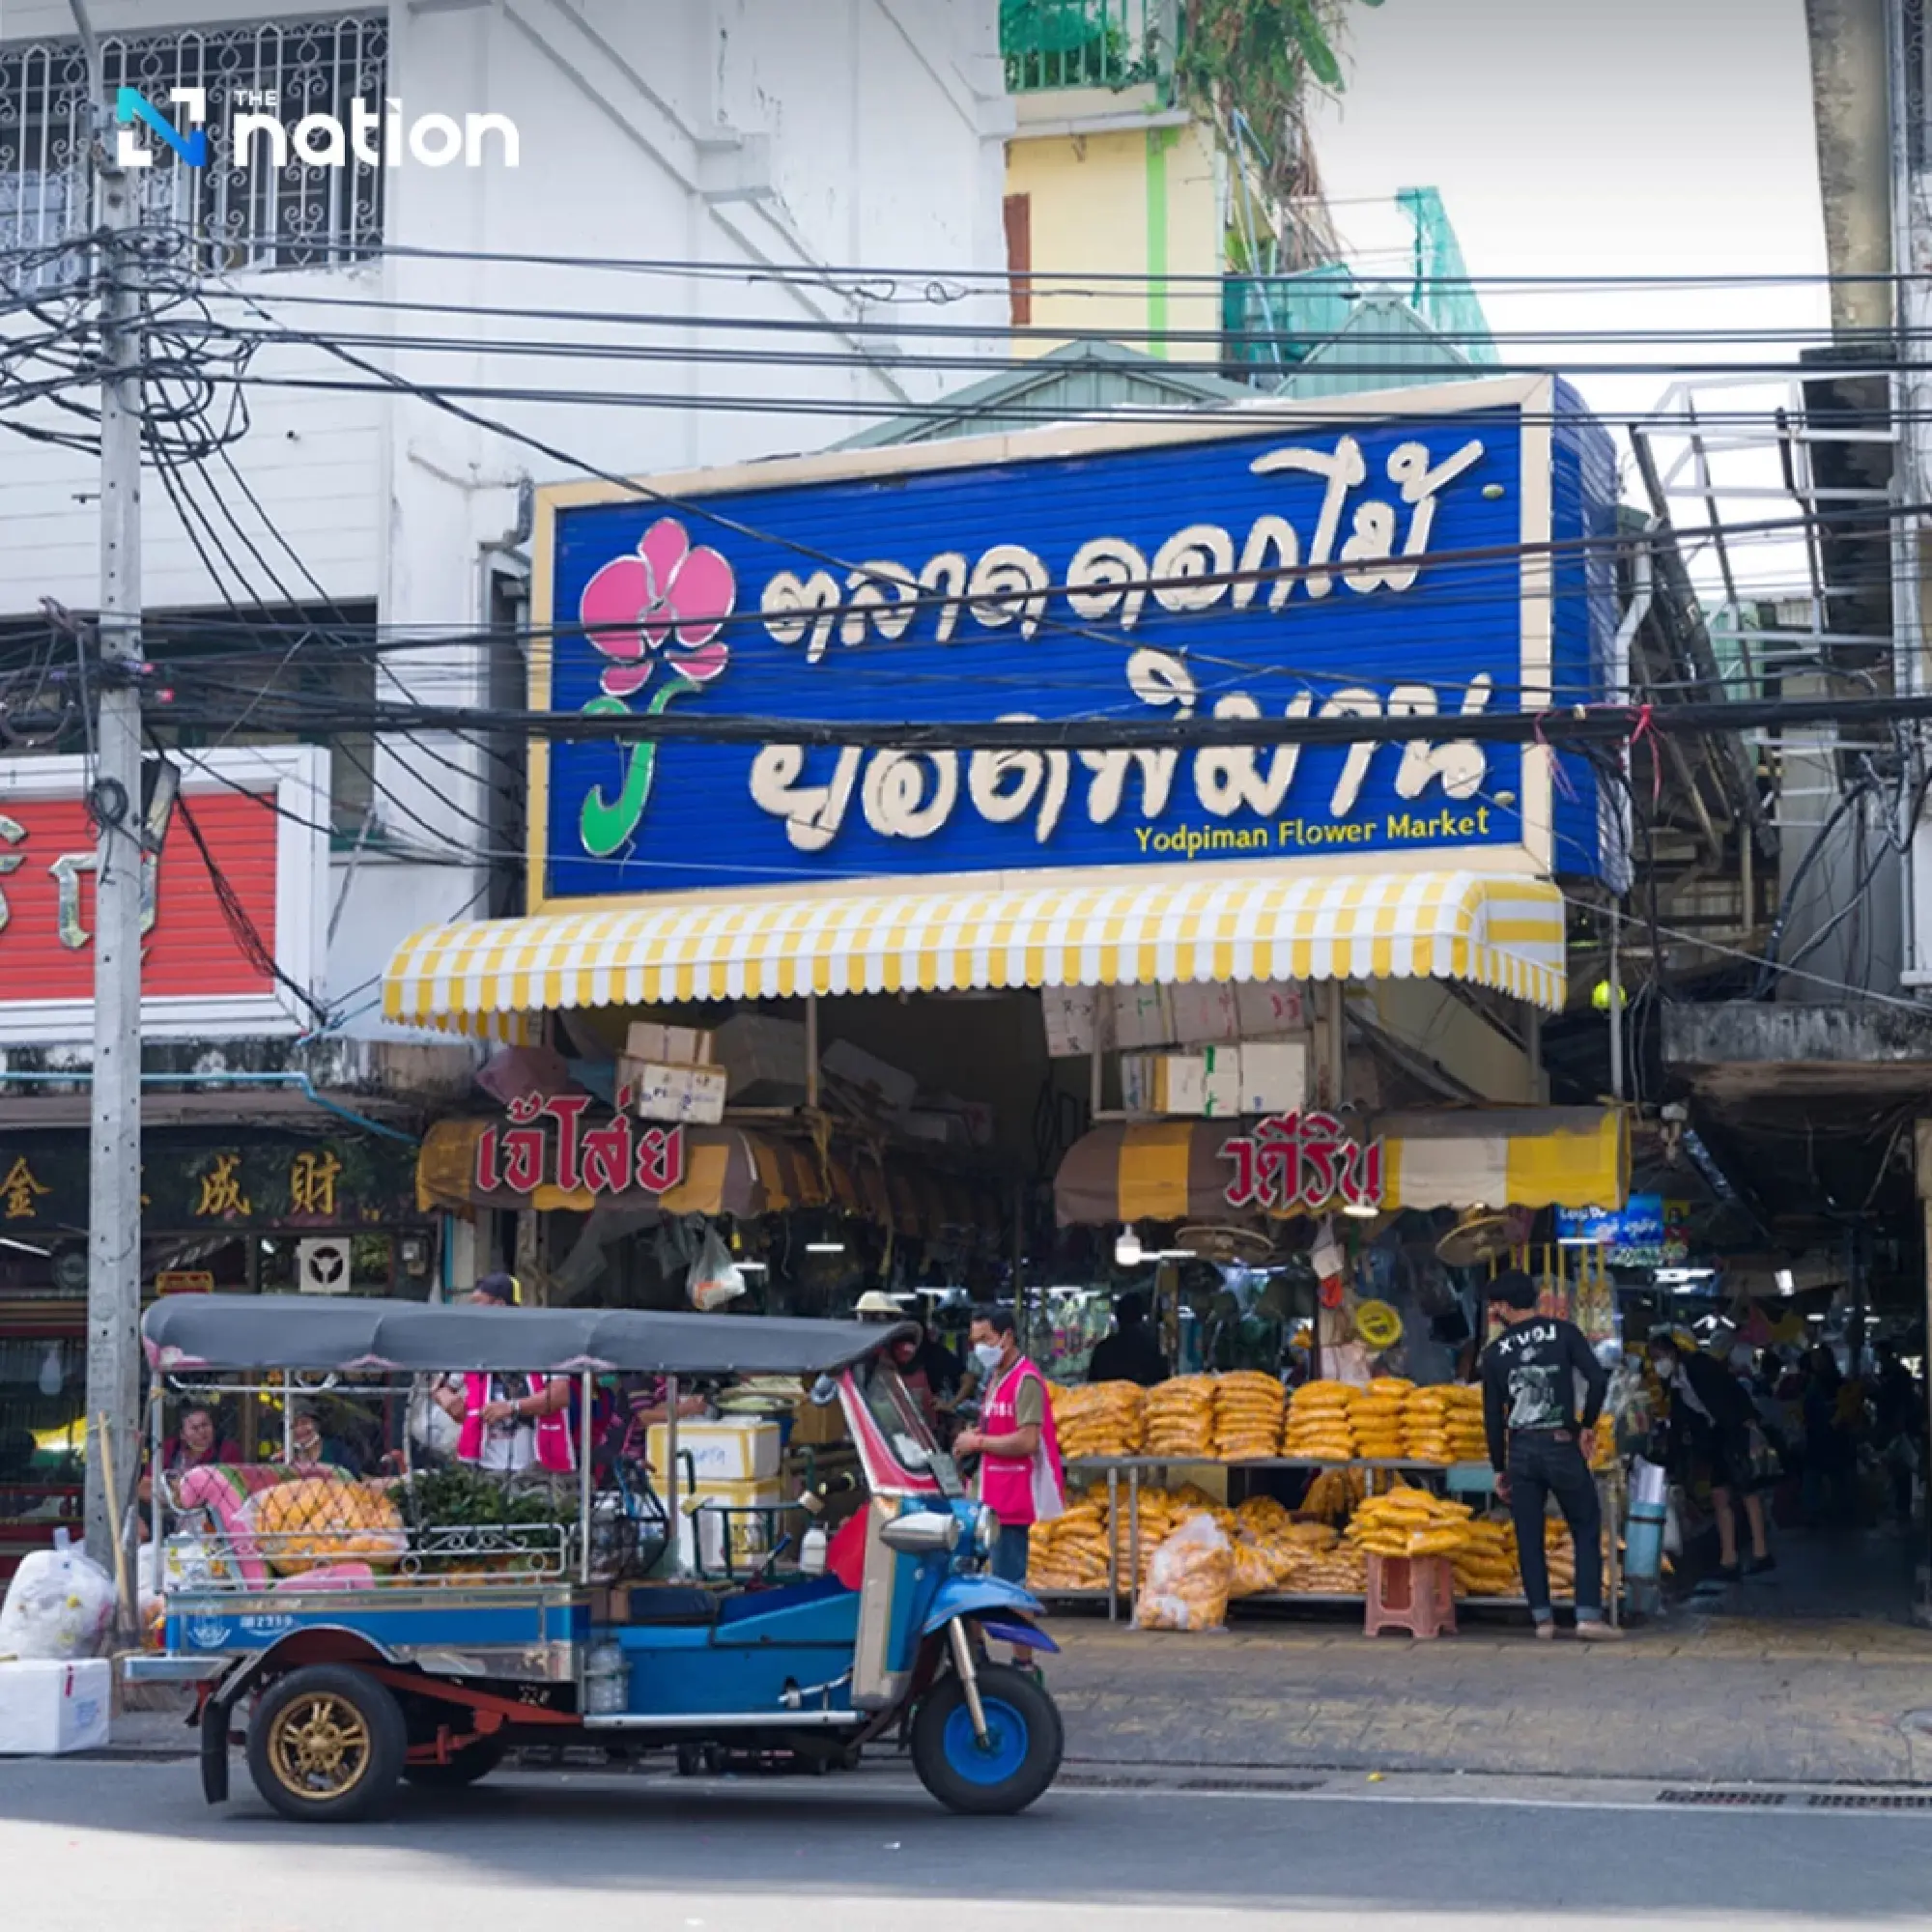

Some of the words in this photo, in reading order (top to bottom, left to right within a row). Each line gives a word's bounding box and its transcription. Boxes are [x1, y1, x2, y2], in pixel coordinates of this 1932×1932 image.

[1134, 823, 1269, 862] Yodpiman
[1278, 817, 1378, 847] Flower
[1386, 805, 1491, 840] Market
[475, 1085, 686, 1195] เจ้โส่ย
